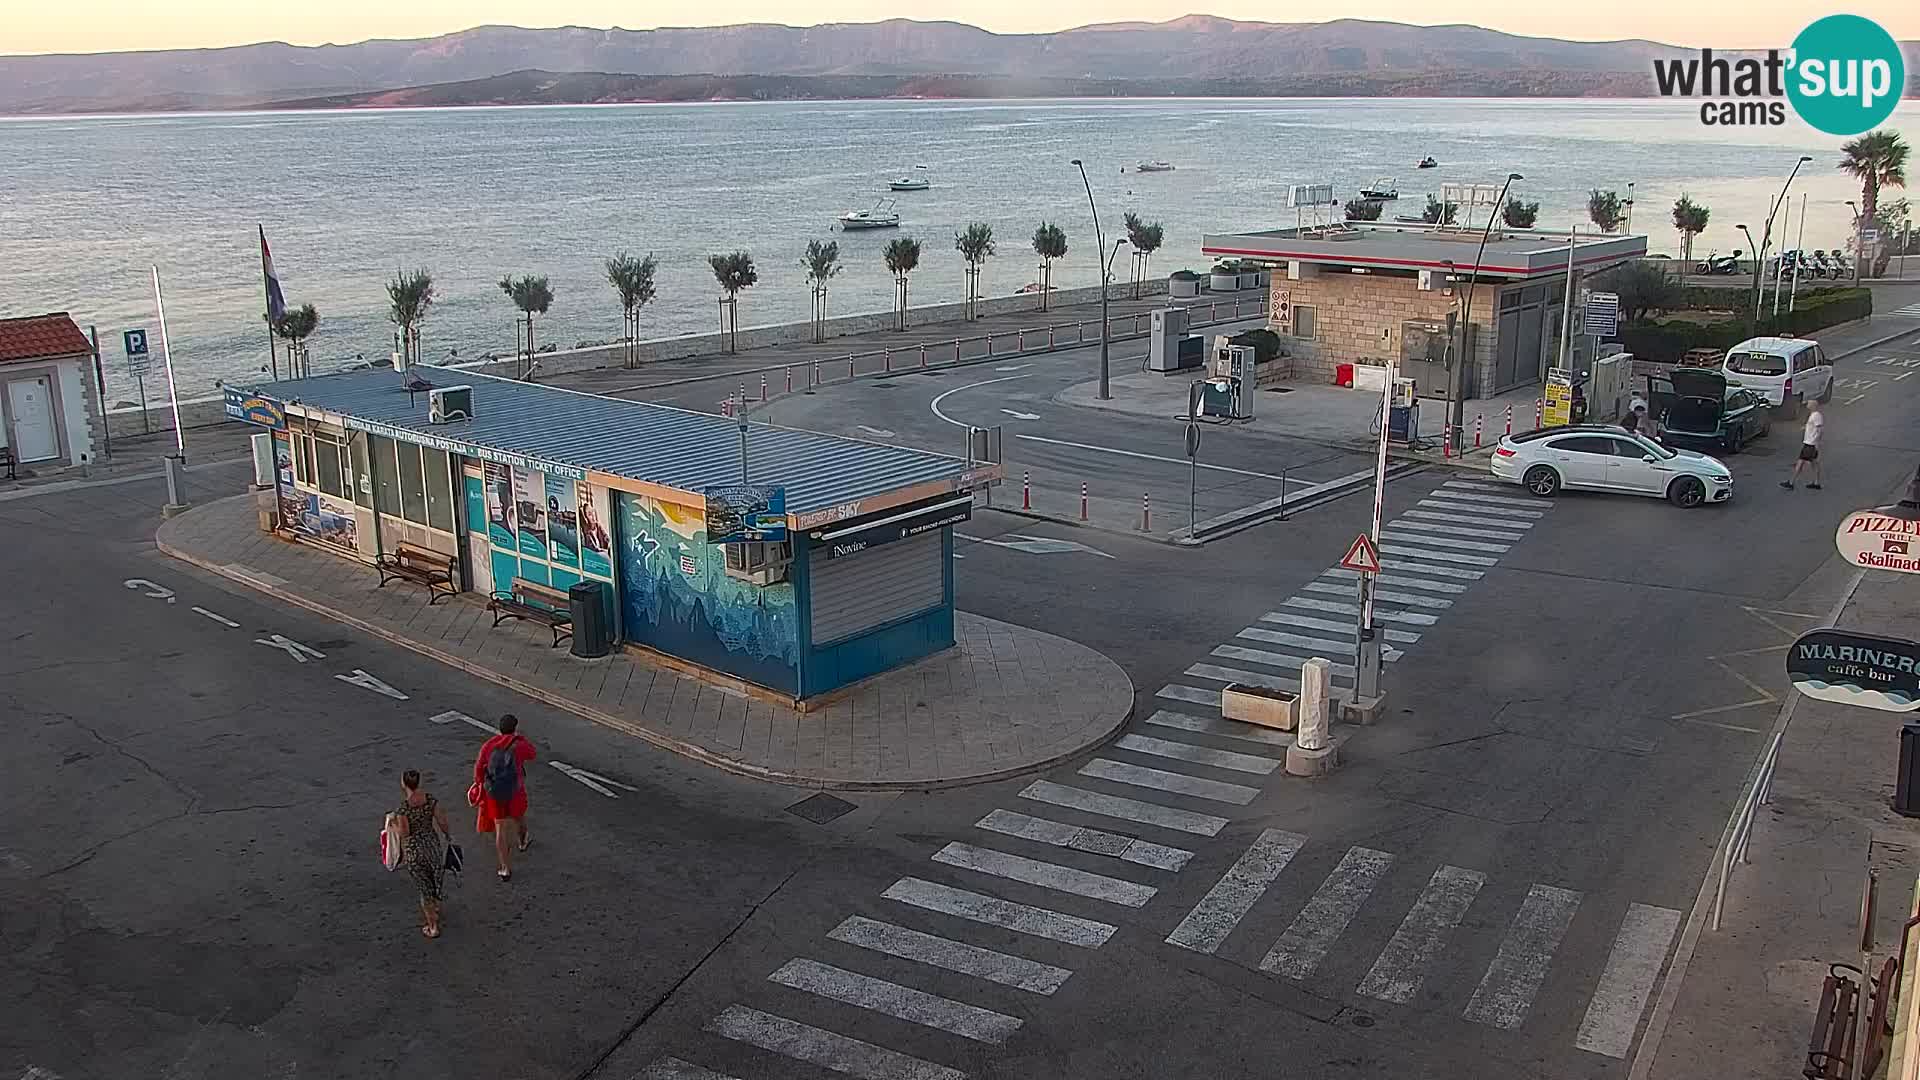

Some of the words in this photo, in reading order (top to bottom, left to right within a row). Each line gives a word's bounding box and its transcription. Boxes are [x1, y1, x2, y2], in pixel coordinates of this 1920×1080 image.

[129, 334, 141, 351] P
[1750, 353, 1767, 361] TAXI
[394, 430, 435, 447] AUTOBUSNA
[435, 440, 467, 454] POSTAJA
[477, 448, 492, 458] BUS
[493, 451, 525, 466] STATION
[527, 459, 553, 473] TICKET
[555, 465, 582, 479] OFFICE
[838, 502, 861, 519] SKY
[1880, 533, 1915, 543] GRILL
[1827, 663, 1864, 678] caffe
[1868, 667, 1895, 682] bar
